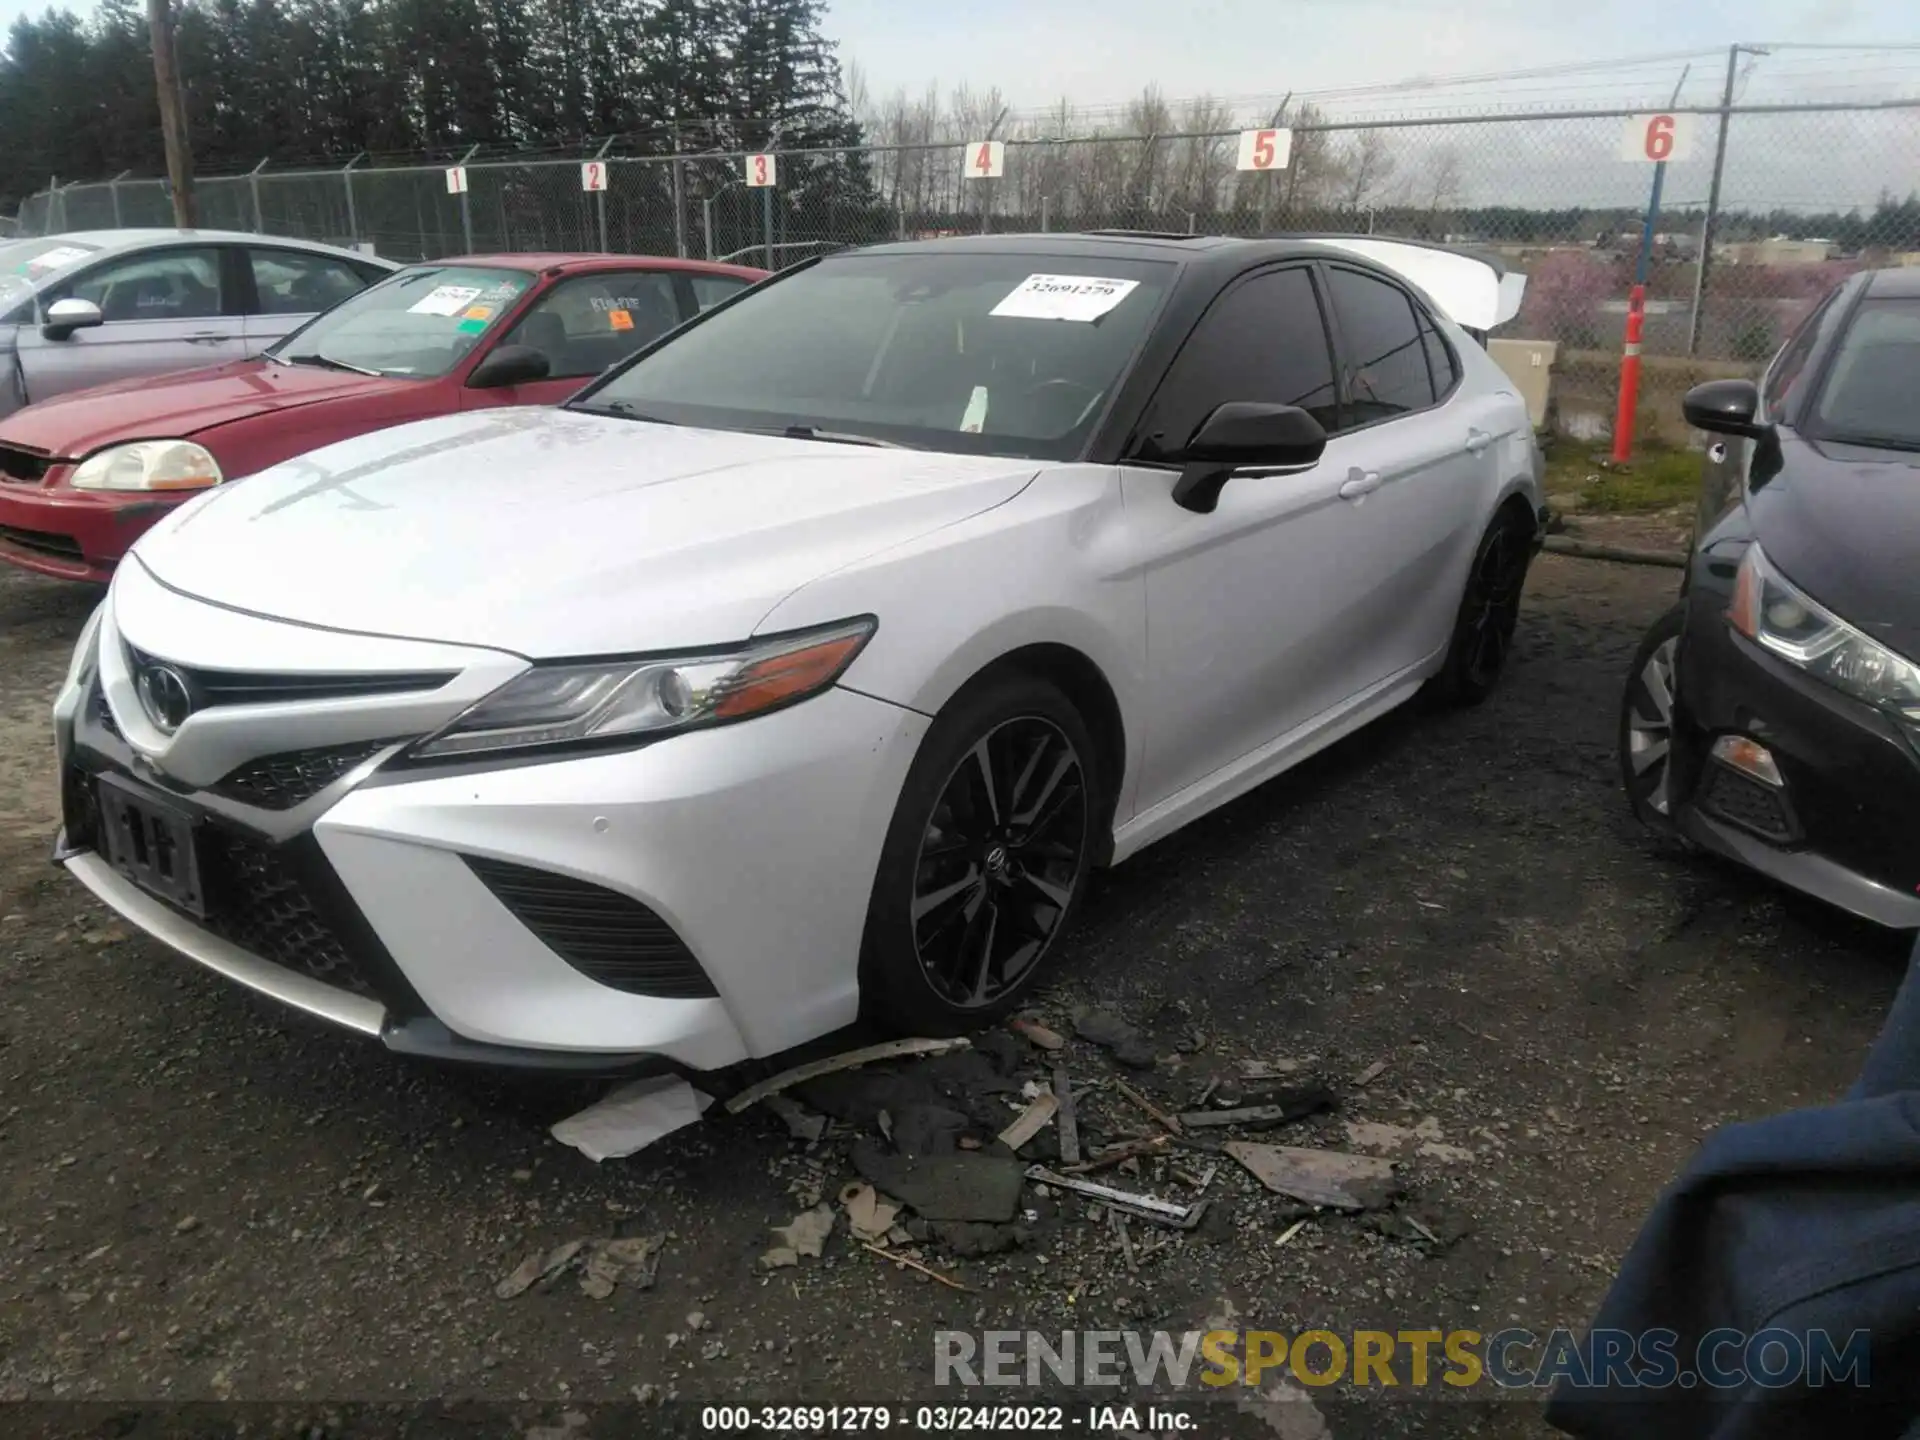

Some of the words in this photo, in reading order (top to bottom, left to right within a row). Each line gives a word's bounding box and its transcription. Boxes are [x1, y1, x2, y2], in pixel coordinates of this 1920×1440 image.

[1253, 130, 1276, 168] 5
[1646, 115, 1675, 160] 6
[755, 154, 767, 185] 3
[975, 142, 992, 175] 4
[452, 168, 461, 190] 1
[588, 164, 600, 189] 2
[1025, 282, 1115, 296] 32691279
